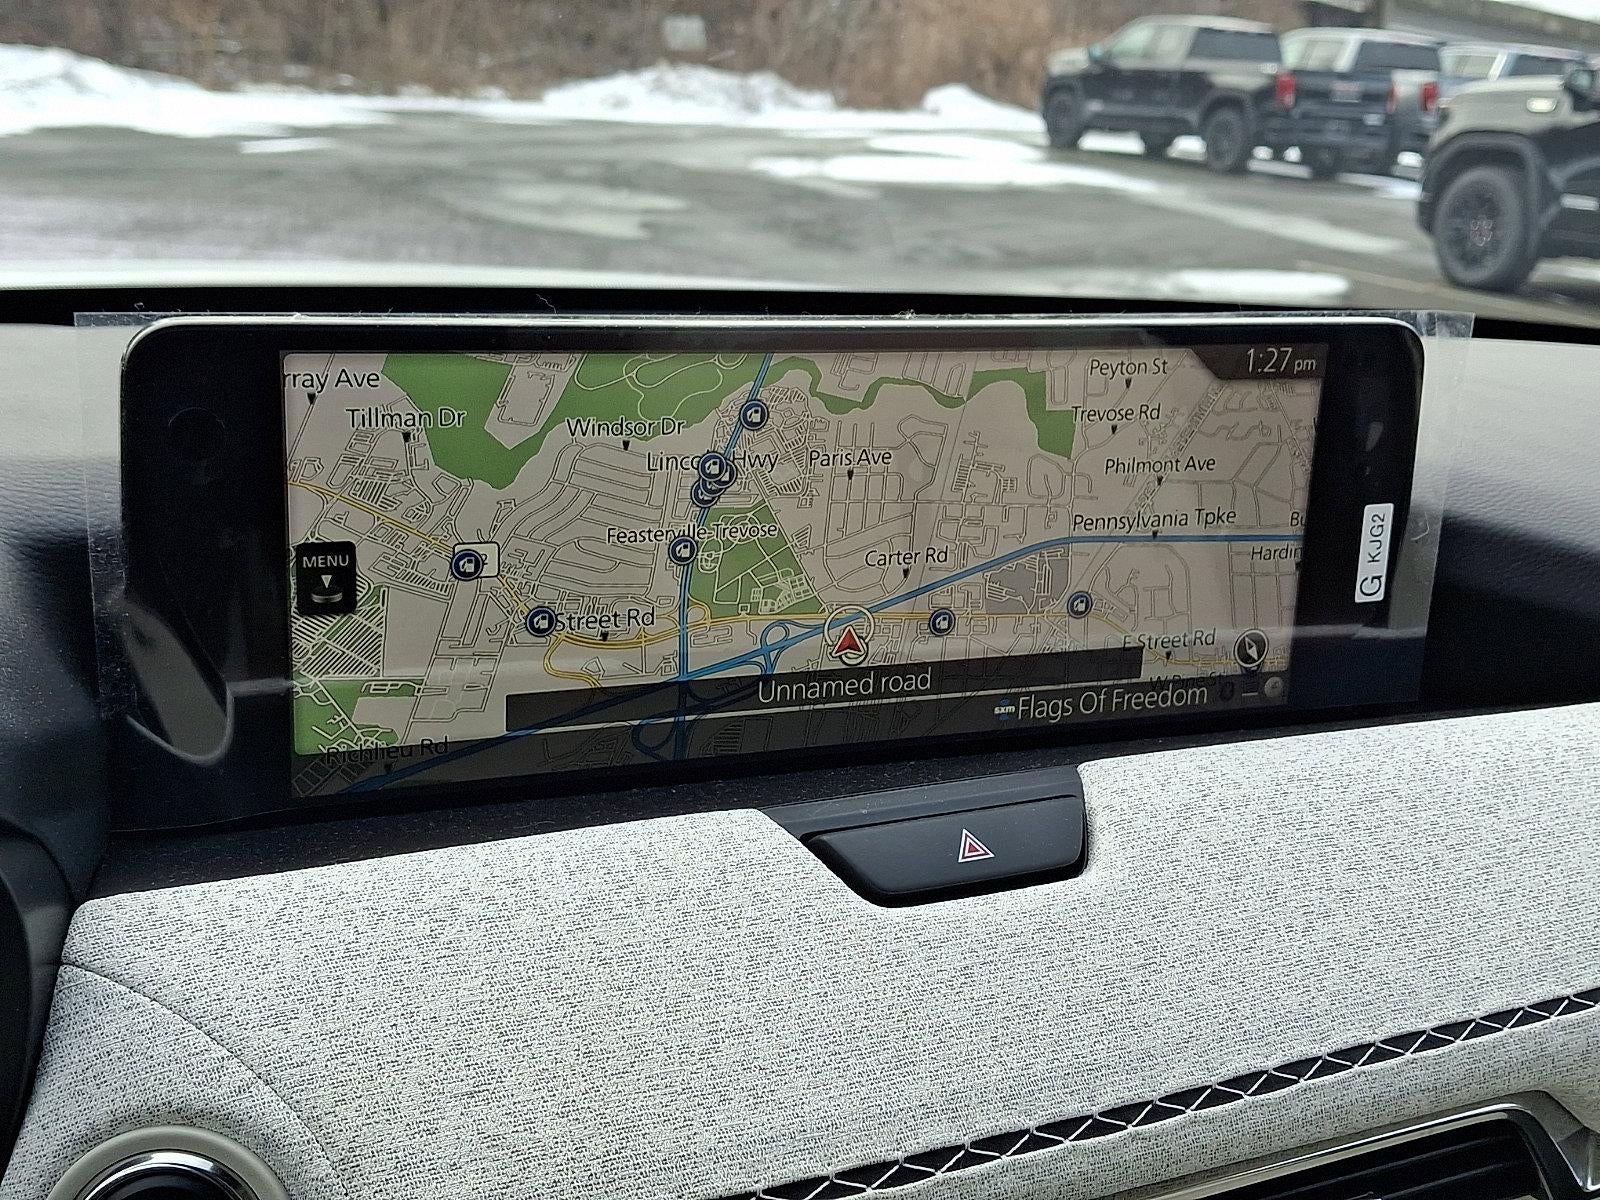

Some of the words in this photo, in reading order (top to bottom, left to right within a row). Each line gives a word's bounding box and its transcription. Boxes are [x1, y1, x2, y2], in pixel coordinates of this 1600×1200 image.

[1089, 358, 1148, 380] Peyton
[1152, 358, 1168, 374] St
[1247, 347, 1292, 373] 1:27
[1294, 360, 1316, 374] pm
[335, 369, 380, 388] Ave
[345, 407, 432, 429] Tillman
[439, 408, 467, 427] Dr
[1071, 405, 1135, 424] Trevose
[1139, 403, 1161, 420] Rd
[566, 415, 656, 437] Windsor
[661, 417, 686, 435] Dr
[647, 450, 710, 471] Linco
[732, 450, 779, 472] Hwy
[809, 450, 852, 468] Paris
[856, 448, 892, 466] Ave
[1105, 456, 1180, 475] Philmont
[1184, 455, 1216, 471] Ave
[1072, 508, 1189, 534] Pennsylvania
[1195, 506, 1237, 529] Tpke
[607, 523, 778, 544] Feasterville-Trevose
[1367, 513, 1386, 563] KJG2
[302, 554, 349, 569] MENU
[865, 550, 921, 567] Carter
[925, 546, 949, 563] Rd
[1359, 575, 1383, 597] G
[554, 613, 621, 632] Street
[627, 607, 655, 628] Rd
[1137, 632, 1188, 650] Street
[1193, 627, 1216, 646] Rd
[758, 671, 874, 703] Unnamed
[881, 667, 932, 693] road
[1018, 695, 1073, 722] Flags
[1079, 690, 1108, 715] Of
[1112, 684, 1208, 713] Freedom
[420, 735, 449, 756] Rd
